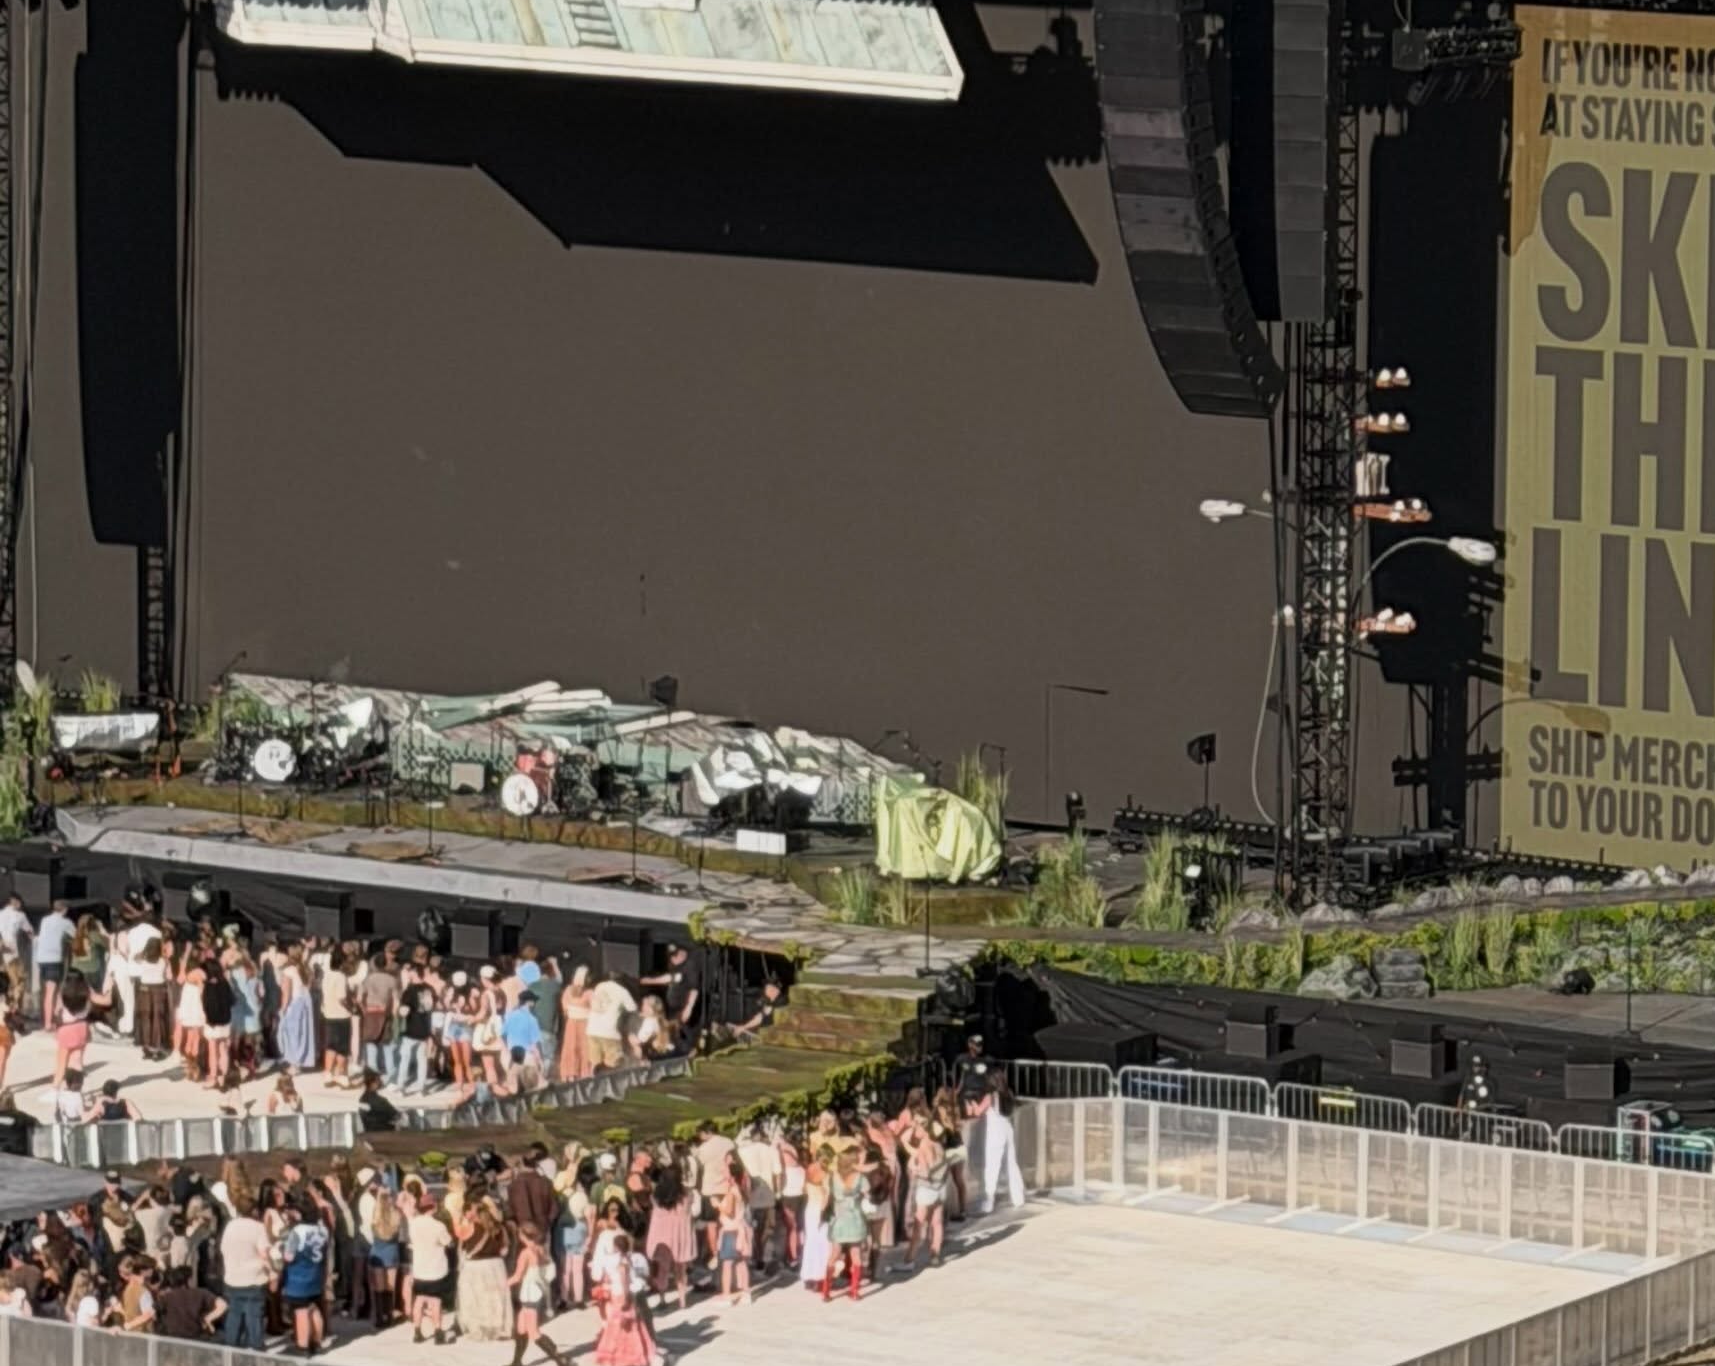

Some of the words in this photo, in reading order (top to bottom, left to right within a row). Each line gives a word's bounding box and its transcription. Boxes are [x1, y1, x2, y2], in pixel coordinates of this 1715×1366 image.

[1541, 37, 1571, 84] IF
[1572, 39, 1679, 92] YOU'RE
[1539, 92, 1577, 137] AT
[1581, 94, 1705, 148] STAYING
[1528, 724, 1607, 778] SHIP
[1528, 779, 1569, 830] TO
[1574, 784, 1664, 841] YOUR
